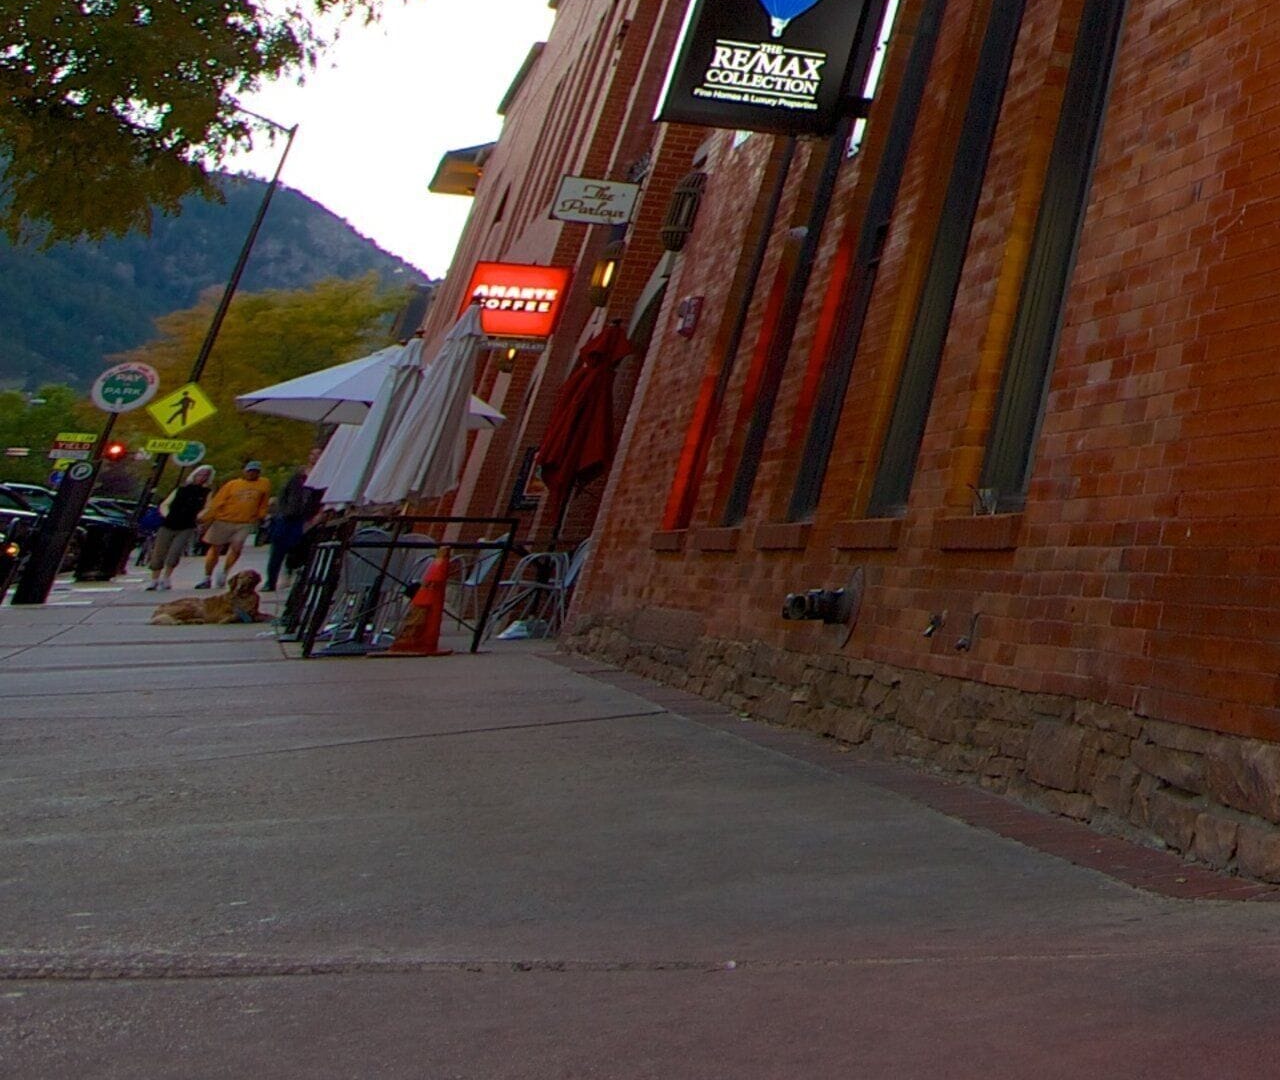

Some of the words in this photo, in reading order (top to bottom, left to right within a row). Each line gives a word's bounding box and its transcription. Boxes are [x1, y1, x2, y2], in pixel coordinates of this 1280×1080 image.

[760, 43, 784, 54] THE
[710, 45, 825, 80] RE/MAX
[706, 69, 818, 94] COLLECTION
[583, 184, 614, 201] The
[559, 199, 625, 219] Parlour
[472, 284, 559, 301] AMANTE
[115, 373, 143, 382] PAY
[103, 387, 142, 396] PARK
[58, 442, 91, 450] YIELD
[151, 441, 184, 450] AHEAD
